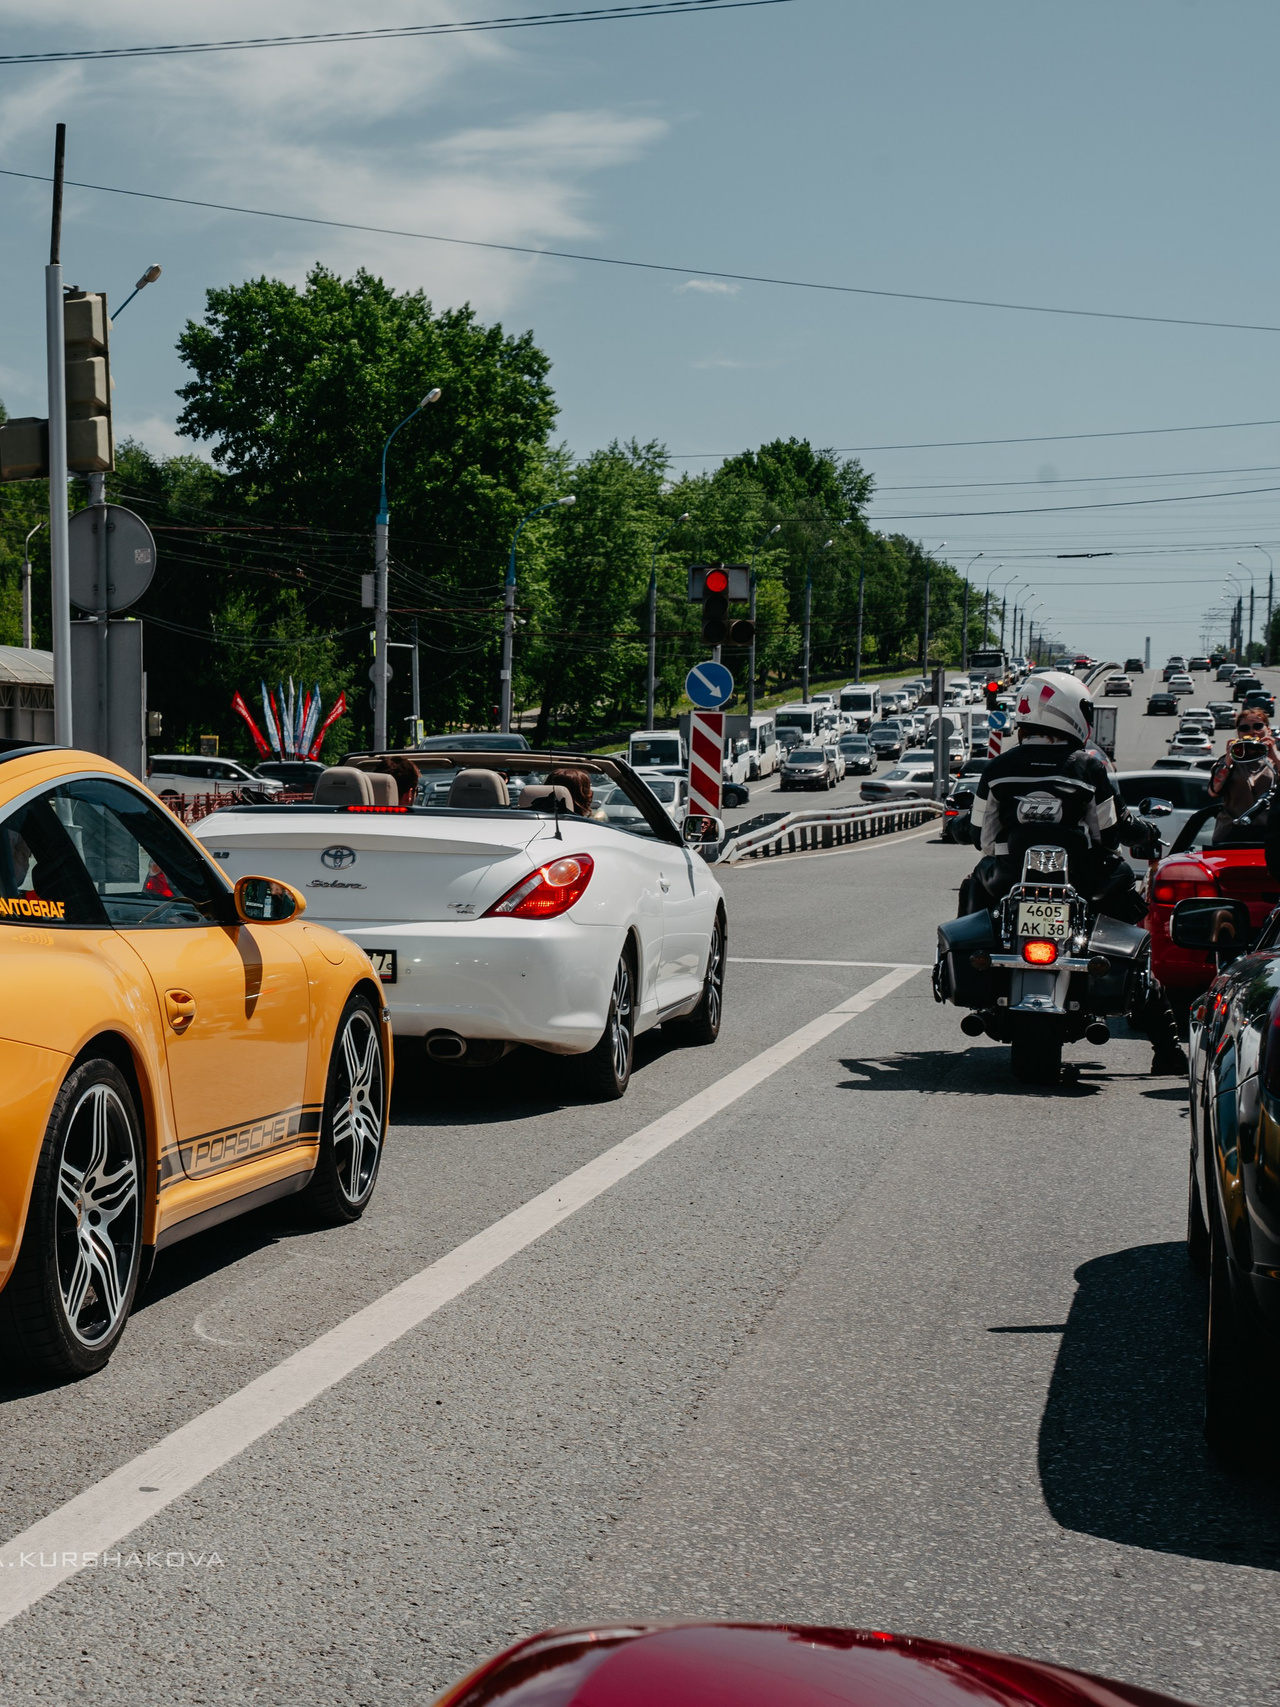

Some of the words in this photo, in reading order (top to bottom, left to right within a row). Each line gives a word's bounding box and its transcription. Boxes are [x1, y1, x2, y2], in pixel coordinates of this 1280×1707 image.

[1026, 905, 1062, 917] 4605
[1047, 923, 1065, 935] 38
[194, 1117, 286, 1168] PORSCHE
